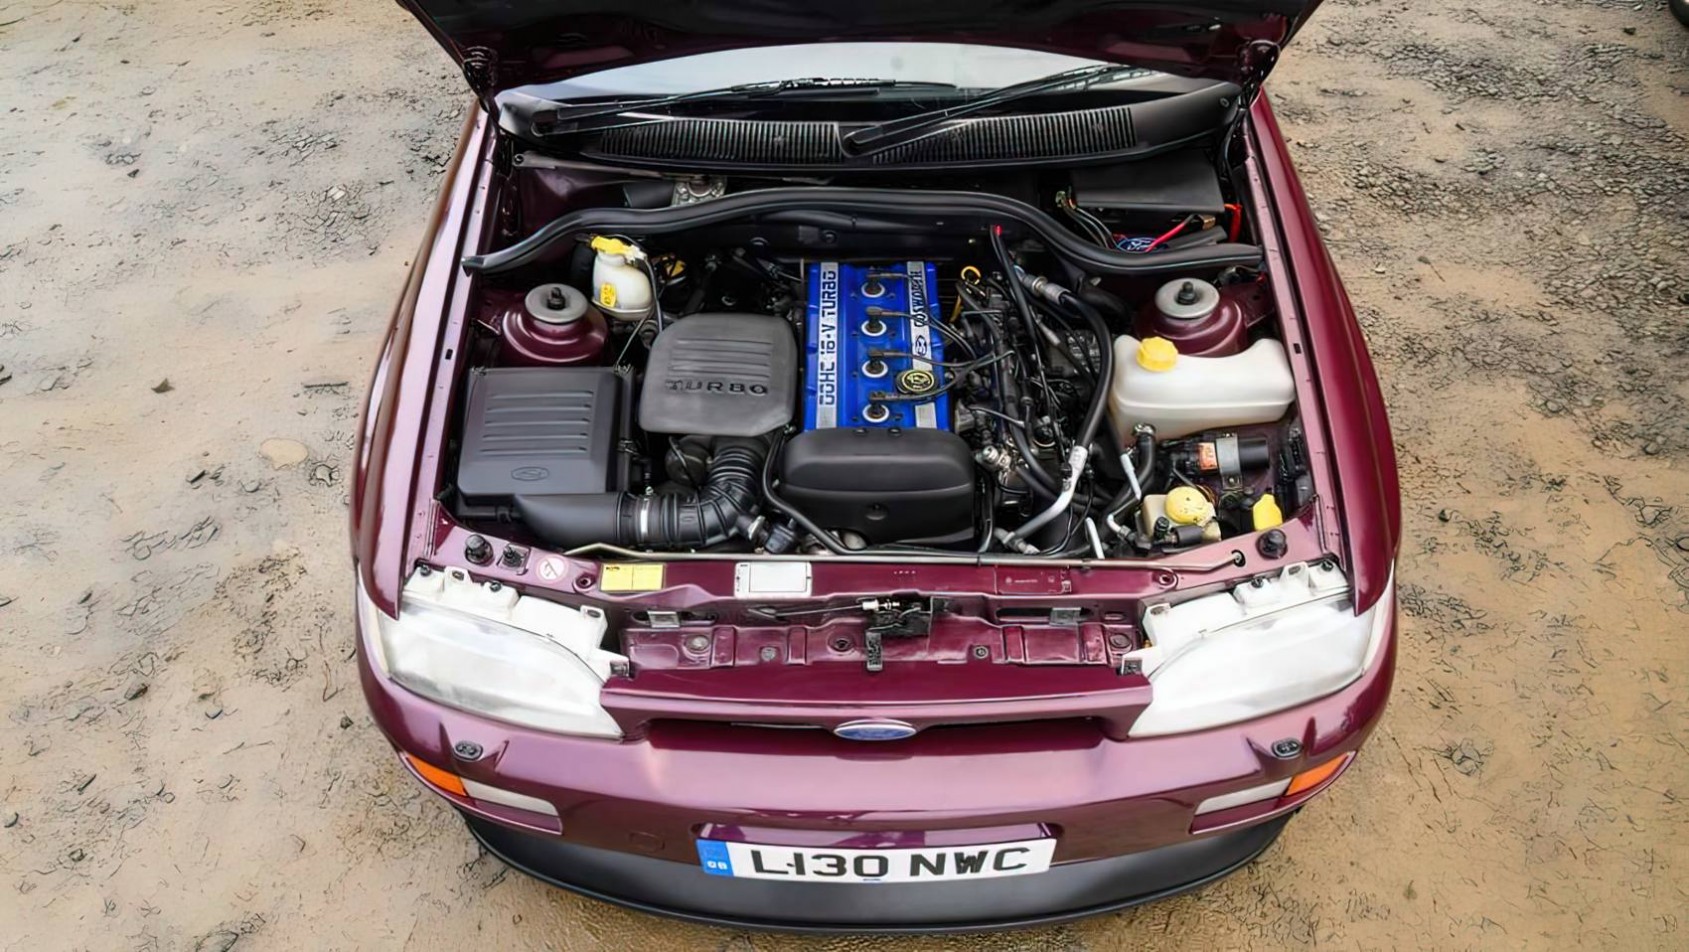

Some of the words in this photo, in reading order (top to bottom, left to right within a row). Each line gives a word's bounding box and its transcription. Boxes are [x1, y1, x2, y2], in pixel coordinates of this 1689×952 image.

[821, 270, 837, 318] TURBO
[664, 379, 768, 395] TURBO
[909, 847, 1031, 877] NWC
